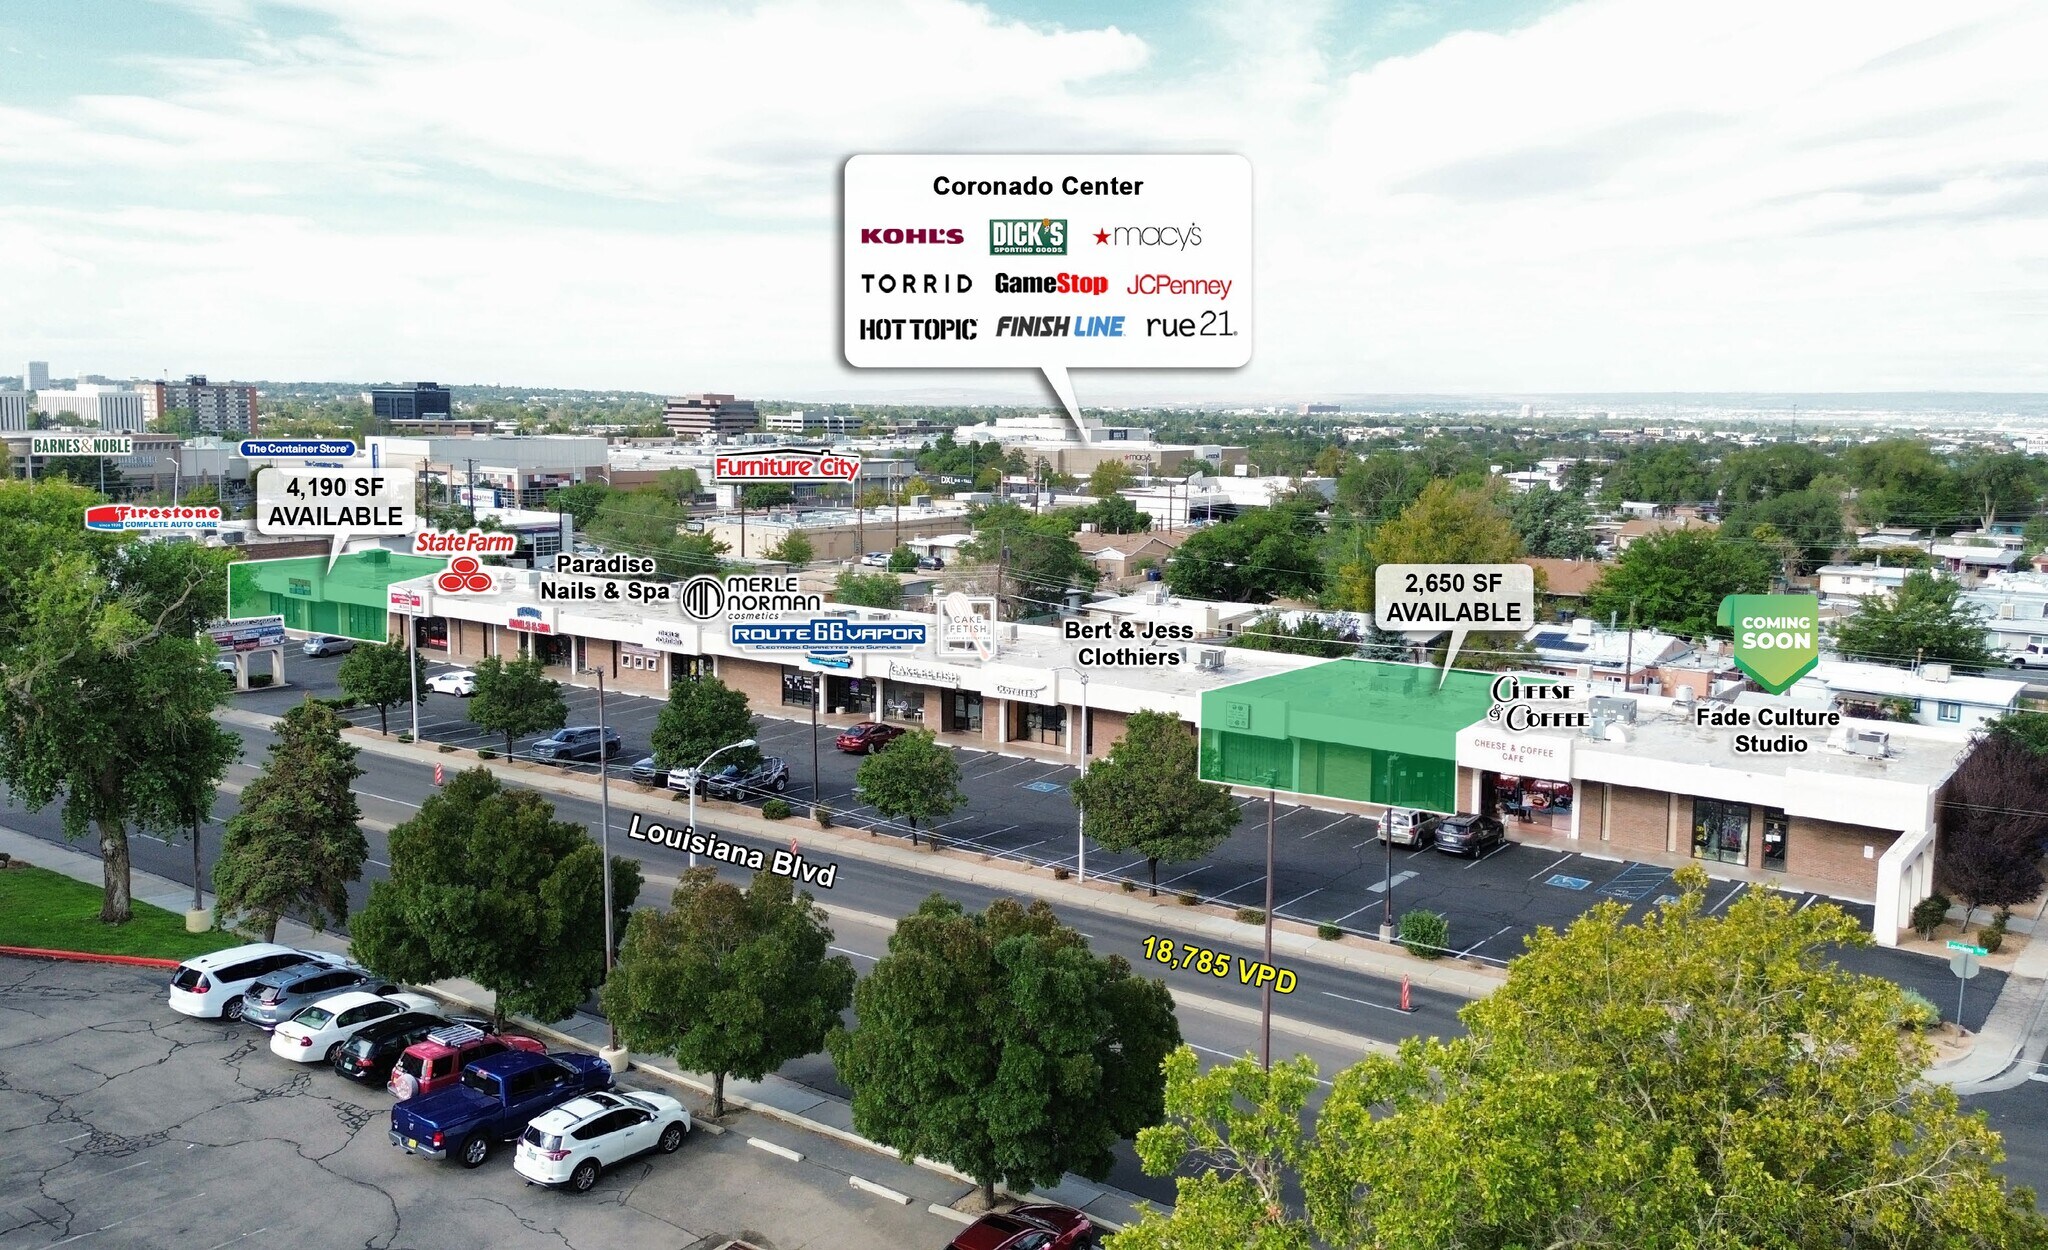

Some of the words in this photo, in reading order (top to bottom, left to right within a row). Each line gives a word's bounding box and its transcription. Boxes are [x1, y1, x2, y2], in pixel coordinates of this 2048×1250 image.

[1474, 739, 1507, 751] CHEESE
[1511, 744, 1516, 752] &
[1520, 745, 1554, 758] COFFEE
[1502, 752, 1524, 763] CAFE
